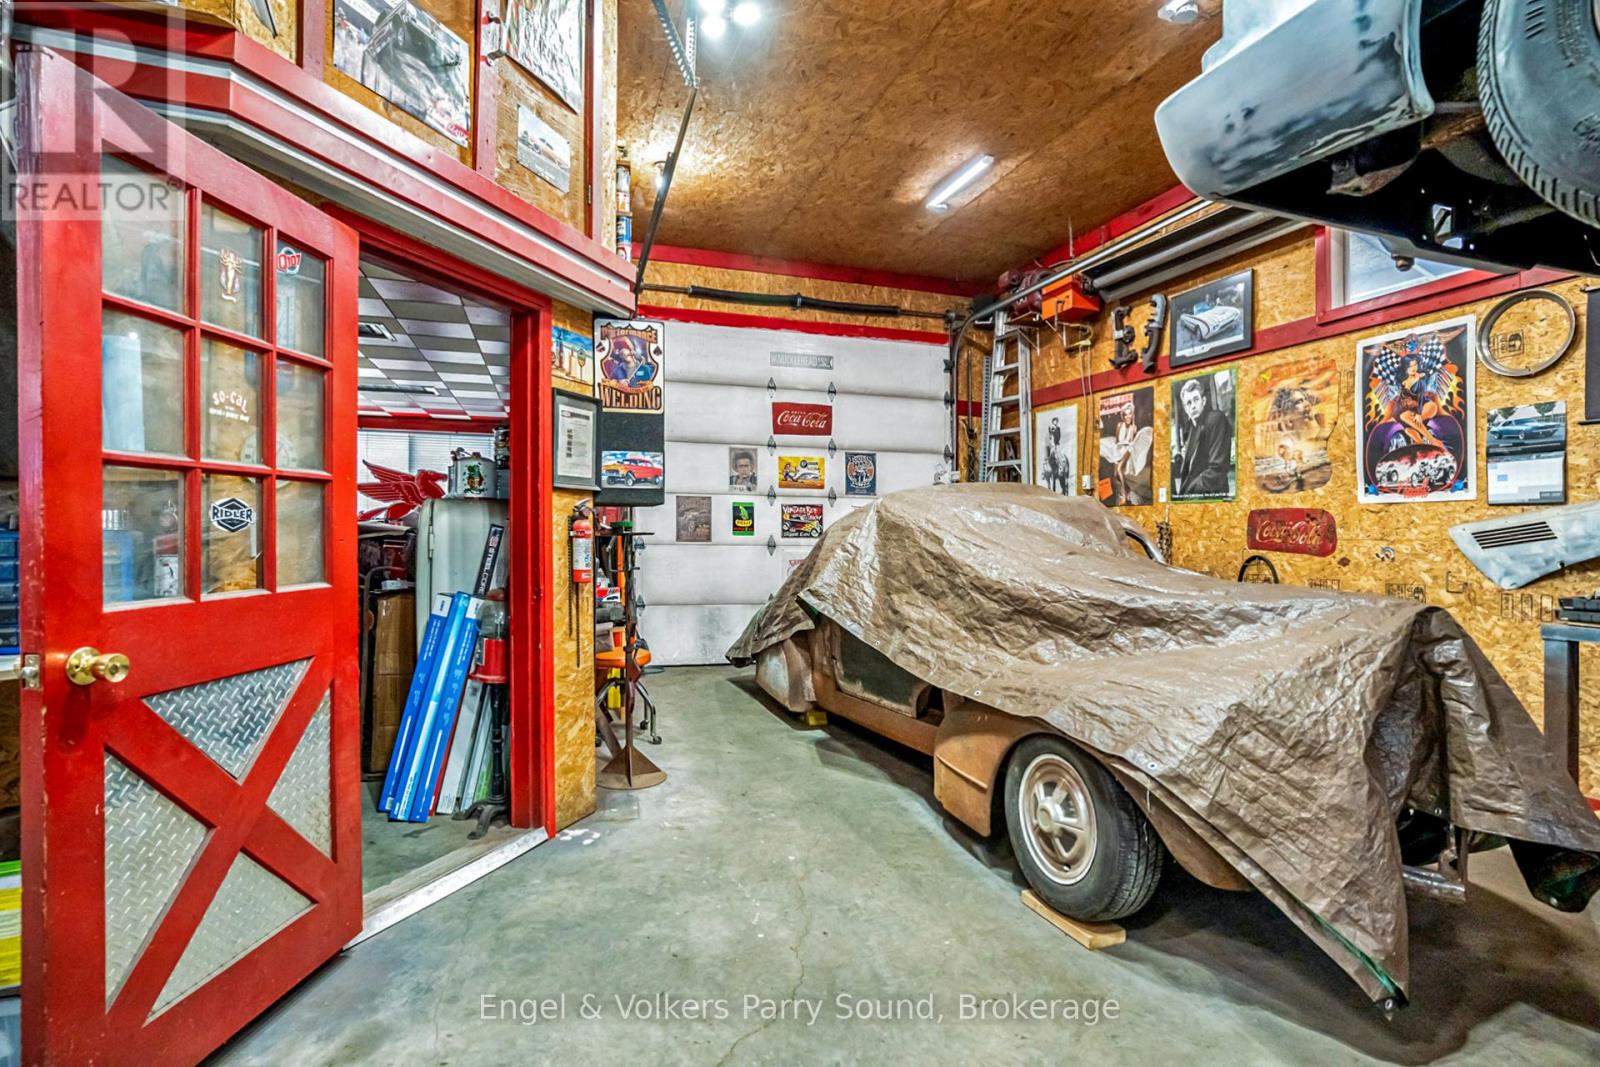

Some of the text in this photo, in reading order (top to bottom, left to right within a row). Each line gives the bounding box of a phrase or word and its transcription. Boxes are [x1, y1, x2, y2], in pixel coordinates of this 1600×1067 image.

[277, 252, 301, 271] Q107
[598, 383, 663, 410] WELDING
[212, 504, 253, 522] RIDLER
